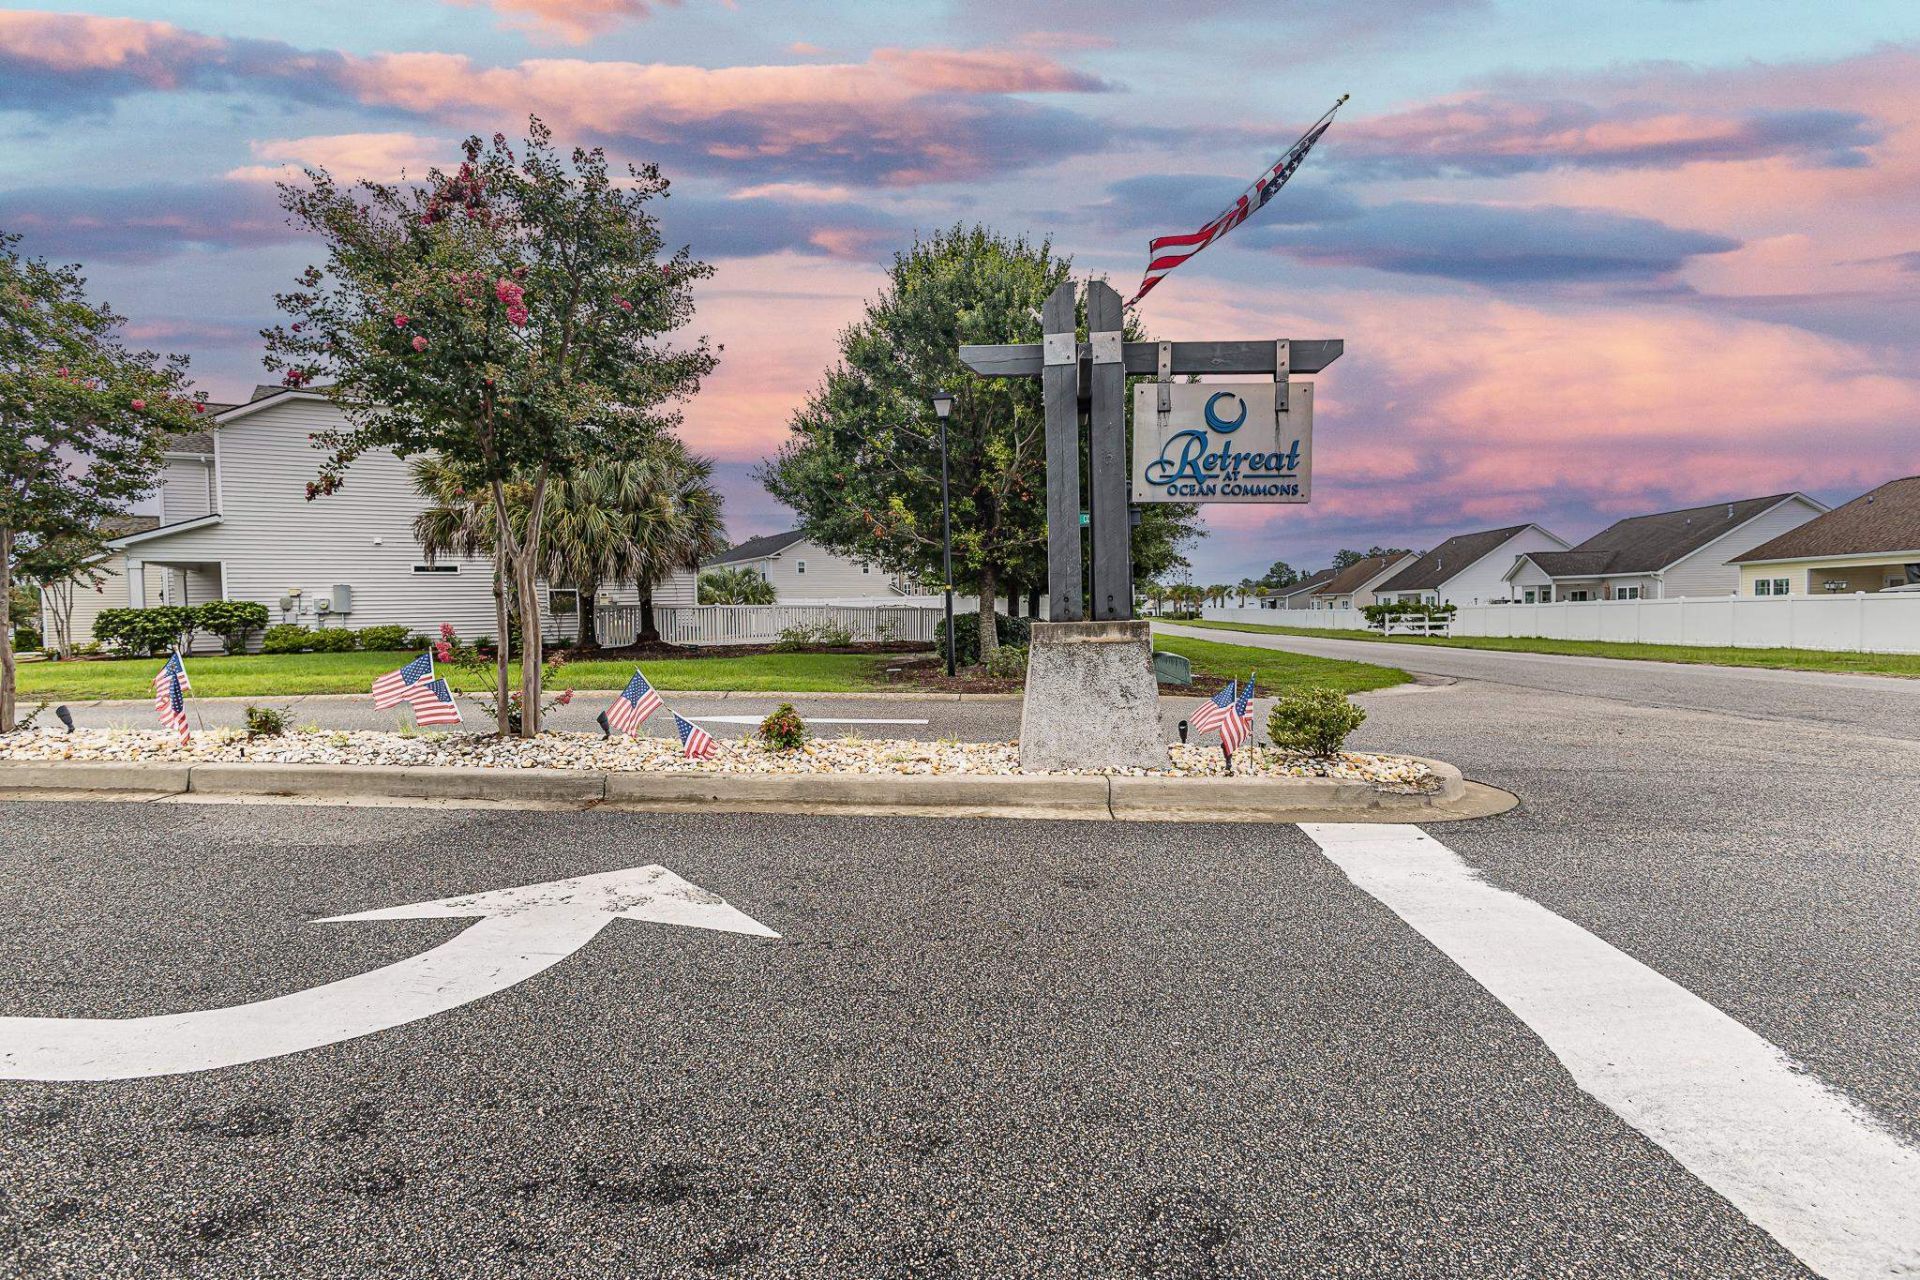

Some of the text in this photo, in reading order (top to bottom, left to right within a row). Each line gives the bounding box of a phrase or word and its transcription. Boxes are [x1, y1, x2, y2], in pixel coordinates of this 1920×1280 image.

[1145, 429, 1300, 485] Retreat
[1223, 470, 1240, 481] AT
[1166, 483, 1299, 496] OCEAN COMMONS
